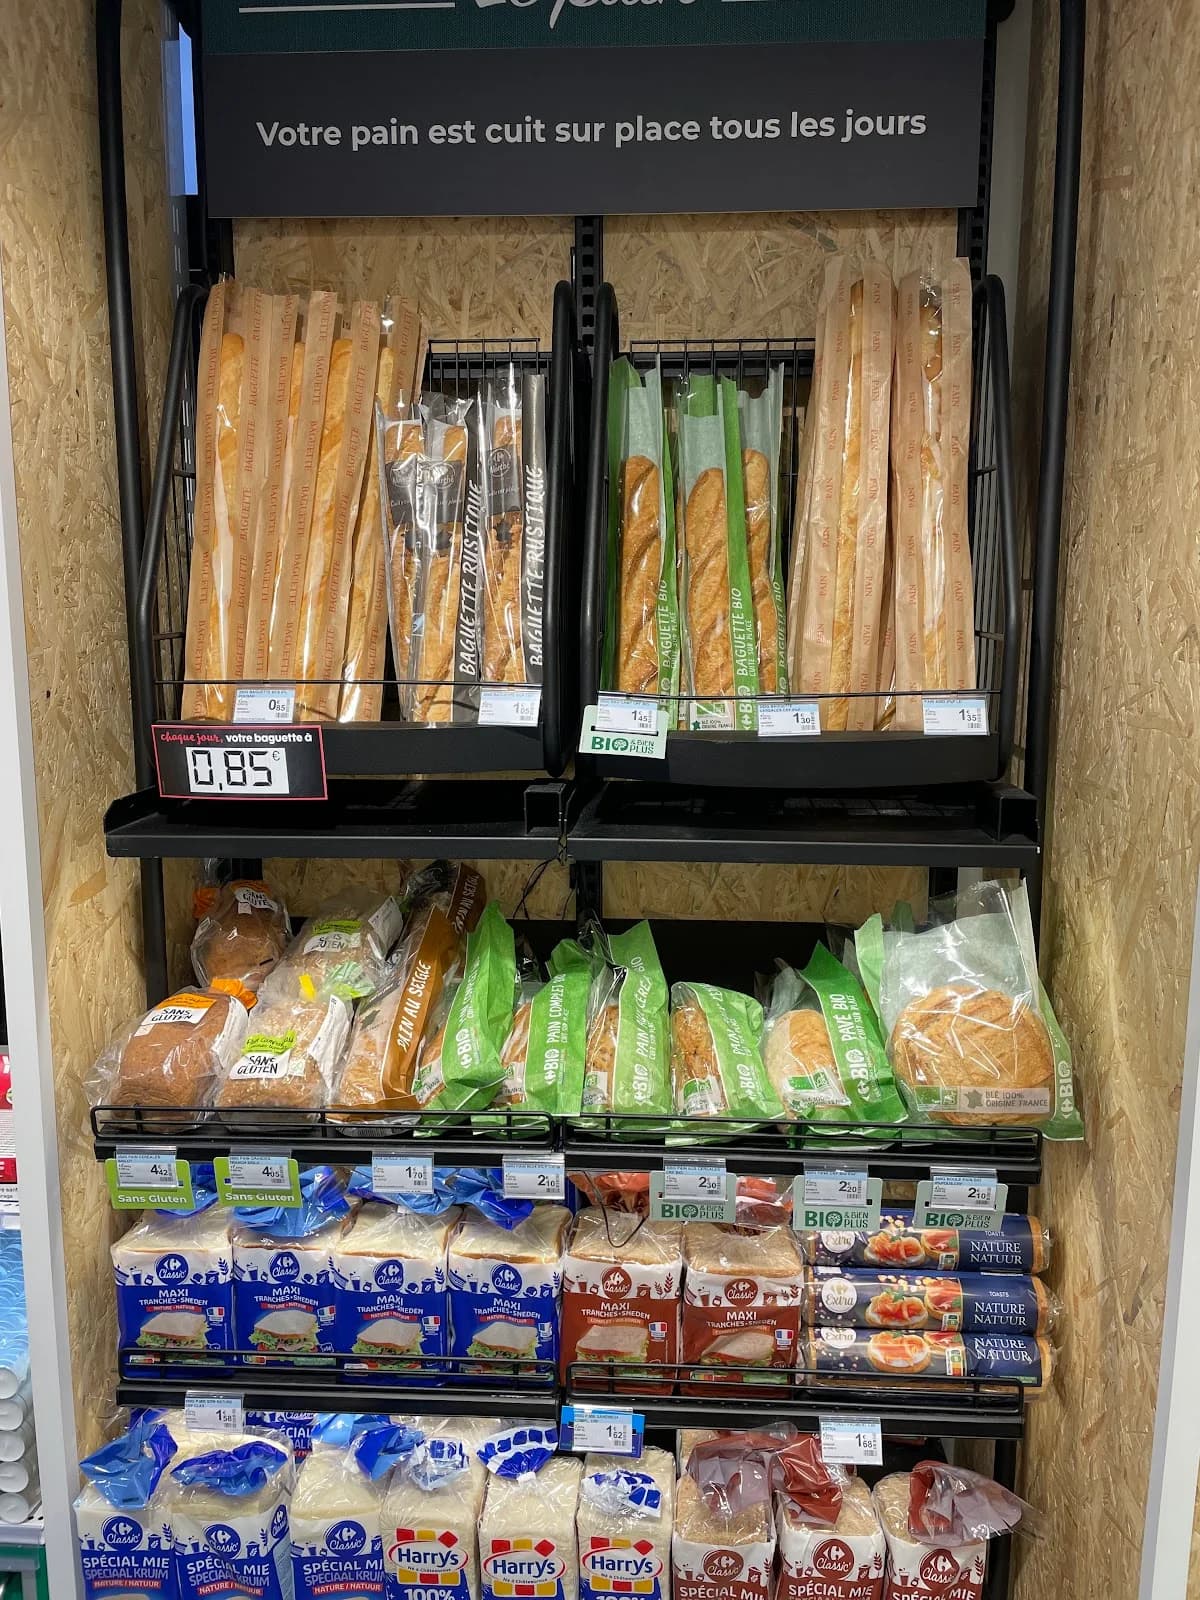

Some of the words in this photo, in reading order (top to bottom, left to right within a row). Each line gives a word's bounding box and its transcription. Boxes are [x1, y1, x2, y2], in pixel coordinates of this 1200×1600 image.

[255, 120, 342, 147] Votre
[350, 119, 419, 151] pain
[427, 119, 477, 145] est
[485, 115, 546, 144] cuit
[554, 118, 605, 143] sur
[614, 113, 701, 148] place
[709, 113, 781, 140] tous
[789, 110, 836, 139] les
[840, 108, 927, 142] jours
[525, 465, 546, 563] RUSTIQUE
[238, 554, 248, 609] BAGUETTE
[657, 579, 668, 601] BIO
[731, 587, 743, 609] BIO
[526, 568, 544, 666] BAGUETTE
[458, 578, 477, 676] BAGUETTE
[657, 603, 673, 668] BAGUETTE
[235, 623, 245, 677] BAGUETTE
[731, 611, 748, 676] BAGUETTE
[160, 732, 195, 745] chaque
[225, 733, 253, 743] votre
[254, 732, 303, 745] baguette
[304, 732, 313, 743] à
[591, 735, 629, 752] BIO
[629, 744, 655, 755] PLUS
[410, 960, 432, 997] SEIGLE
[406, 998, 421, 1017] AU
[830, 993, 846, 1011] BIO
[151, 1014, 193, 1022] GLUTEN
[162, 1008, 191, 1016] SANS
[546, 1020, 560, 1043] PAIN
[836, 1012, 856, 1043] PAVÉ
[455, 1027, 472, 1059] BIO
[637, 1025, 650, 1057] PAIN
[248, 1055, 276, 1066] SANS
[543, 1048, 559, 1072] BIO
[845, 1048, 869, 1080] BIO
[237, 1063, 279, 1075] GLUTEN
[634, 1063, 649, 1091] BIO
[1057, 1060, 1073, 1098] BIO
[985, 1099, 1017, 1108] ORIGINE
[1018, 1099, 1048, 1107] FRANCE
[118, 1194, 147, 1203] Sans
[149, 1194, 187, 1204] Gluten
[225, 1192, 254, 1201] Sans
[255, 1192, 295, 1202] Gluten
[661, 1204, 699, 1219] BIO
[700, 1210, 724, 1220] PLUS
[804, 1210, 843, 1228] BIO
[844, 1217, 869, 1228] PLUS
[925, 1212, 965, 1227] BIO
[964, 1219, 991, 1228] PLUS
[970, 1242, 1022, 1253] NATURE
[970, 1254, 1023, 1266] NATUUR
[158, 1269, 187, 1279] Classic
[272, 1285, 300, 1297] MAXI
[494, 1278, 521, 1292] Classic
[603, 1280, 630, 1293] Classic
[158, 1289, 189, 1298] MAXI
[377, 1294, 404, 1306] MAXI
[727, 1289, 756, 1299] Classic
[493, 1298, 521, 1311] MAXI
[600, 1302, 630, 1312] MAXI
[825, 1294, 855, 1307] Extra
[974, 1302, 1026, 1315] NATURE
[726, 1311, 757, 1321] MAXI
[974, 1314, 1027, 1326] NATUUR
[974, 1337, 1027, 1349] NATURE
[976, 1349, 1032, 1364] NATUUR
[106, 1532, 140, 1544] Classic
[329, 1537, 364, 1551] Classic
[83, 1556, 139, 1569] SPÉCIAL
[143, 1557, 170, 1569] MIE
[397, 1547, 459, 1568] Harry's
[243, 1563, 270, 1576] MIE
[303, 1558, 362, 1575] SPÉCIAL
[492, 1558, 556, 1578] Harry's
[591, 1555, 653, 1574] Harry's
[707, 1565, 740, 1577] Classic
[815, 1558, 850, 1572] Classic
[85, 1568, 133, 1580] SPECIAAL
[133, 1568, 169, 1580] KRUIM
[305, 1571, 356, 1587] SPECIAAL
[128, 1580, 160, 1588] NATUUR
[199, 1583, 230, 1595] NATURE
[314, 1583, 346, 1594] NATURE
[350, 1582, 381, 1592] NATUUR
[788, 1579, 845, 1597] SPÉCIAL
[849, 1586, 874, 1598] MIE
[680, 1585, 737, 1599] SPÉCIAL
[949, 1588, 976, 1600] MIE
